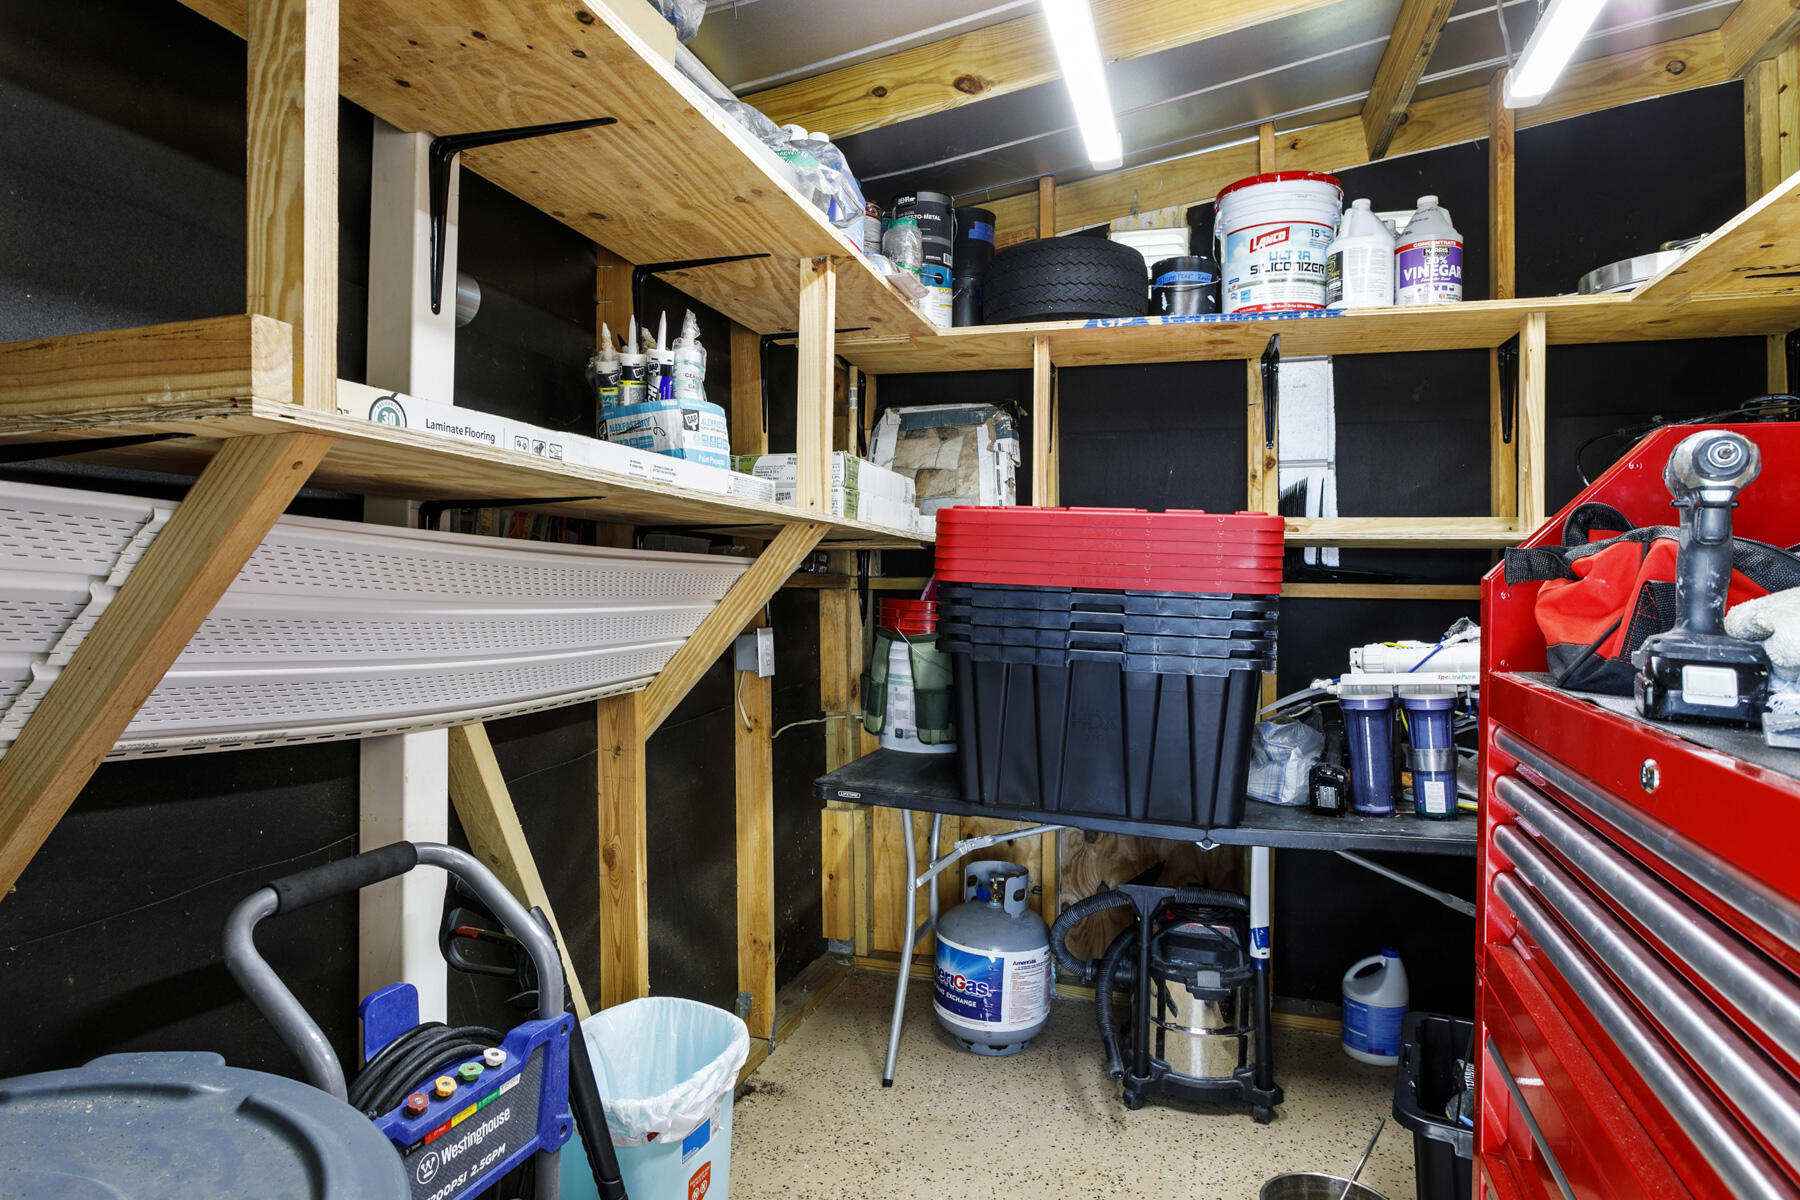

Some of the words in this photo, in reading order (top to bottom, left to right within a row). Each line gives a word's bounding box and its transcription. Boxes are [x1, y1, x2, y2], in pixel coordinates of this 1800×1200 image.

[1251, 230, 1288, 252] LANCO
[1310, 228, 1320, 238] 15
[1269, 250, 1311, 261] ULTRA
[1425, 256, 1448, 265] 30%
[1250, 261, 1325, 275] SILICONIZER
[1403, 264, 1462, 281] VINEGAR
[381, 411, 396, 425] 30
[686, 414, 698, 424] DAP
[425, 418, 464, 436] Laminate
[464, 427, 496, 444] Flooring
[936, 965, 989, 997] eriGas
[945, 991, 977, 1008] EXCHANGE
[441, 1108, 511, 1166] Westinghouse
[470, 1142, 507, 1178] 2.5GPM
